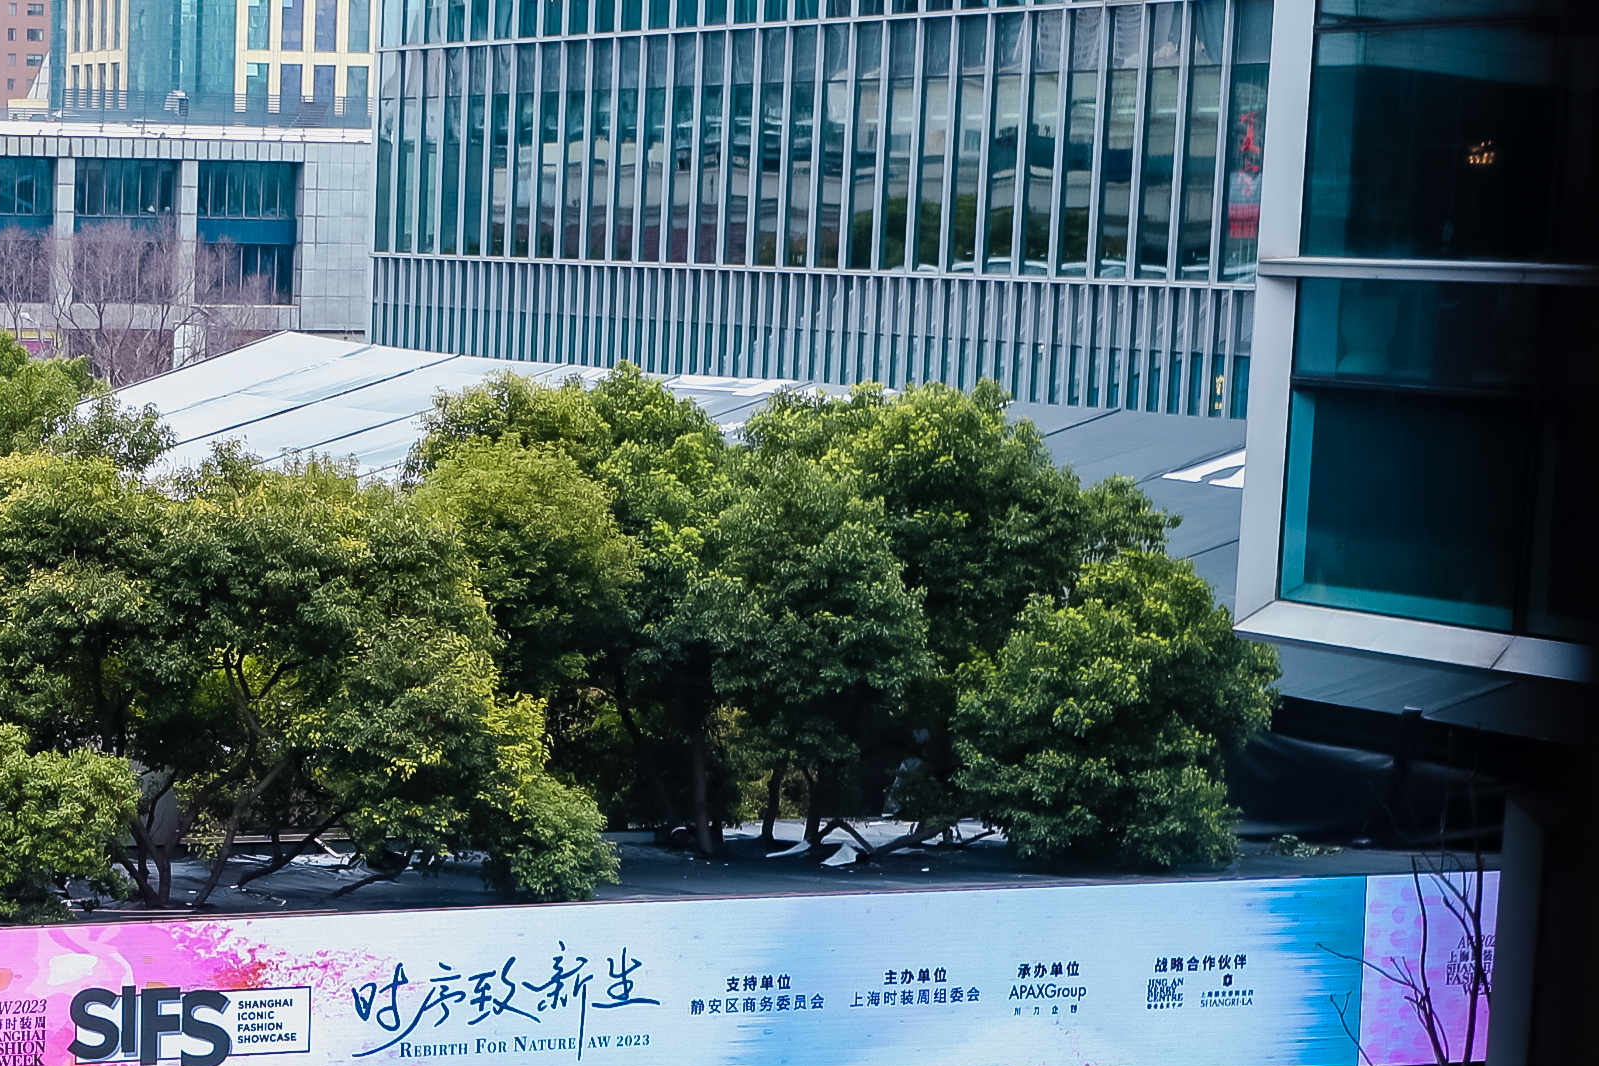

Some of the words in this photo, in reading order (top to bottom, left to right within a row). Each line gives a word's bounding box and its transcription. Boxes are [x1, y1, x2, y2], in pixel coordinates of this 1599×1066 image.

[1017, 961, 1080, 979] 承办单位
[1153, 953, 1247, 973] 战略合作伙伴
[726, 974, 793, 993] 支持单位
[884, 967, 949, 986] 主办单位
[849, 986, 981, 1009] 上海时装周组委会
[1008, 983, 1087, 1002] APAXGroup
[237, 998, 294, 1010] SHANGHAI
[689, 993, 826, 1016] 静安区商务委员会
[237, 1010, 275, 1021] ICONIC
[237, 1022, 284, 1032] FASHION
[237, 1032, 298, 1045] SHOWCASE
[587, 1036, 612, 1049] AW
[615, 1034, 651, 1048] 2023
